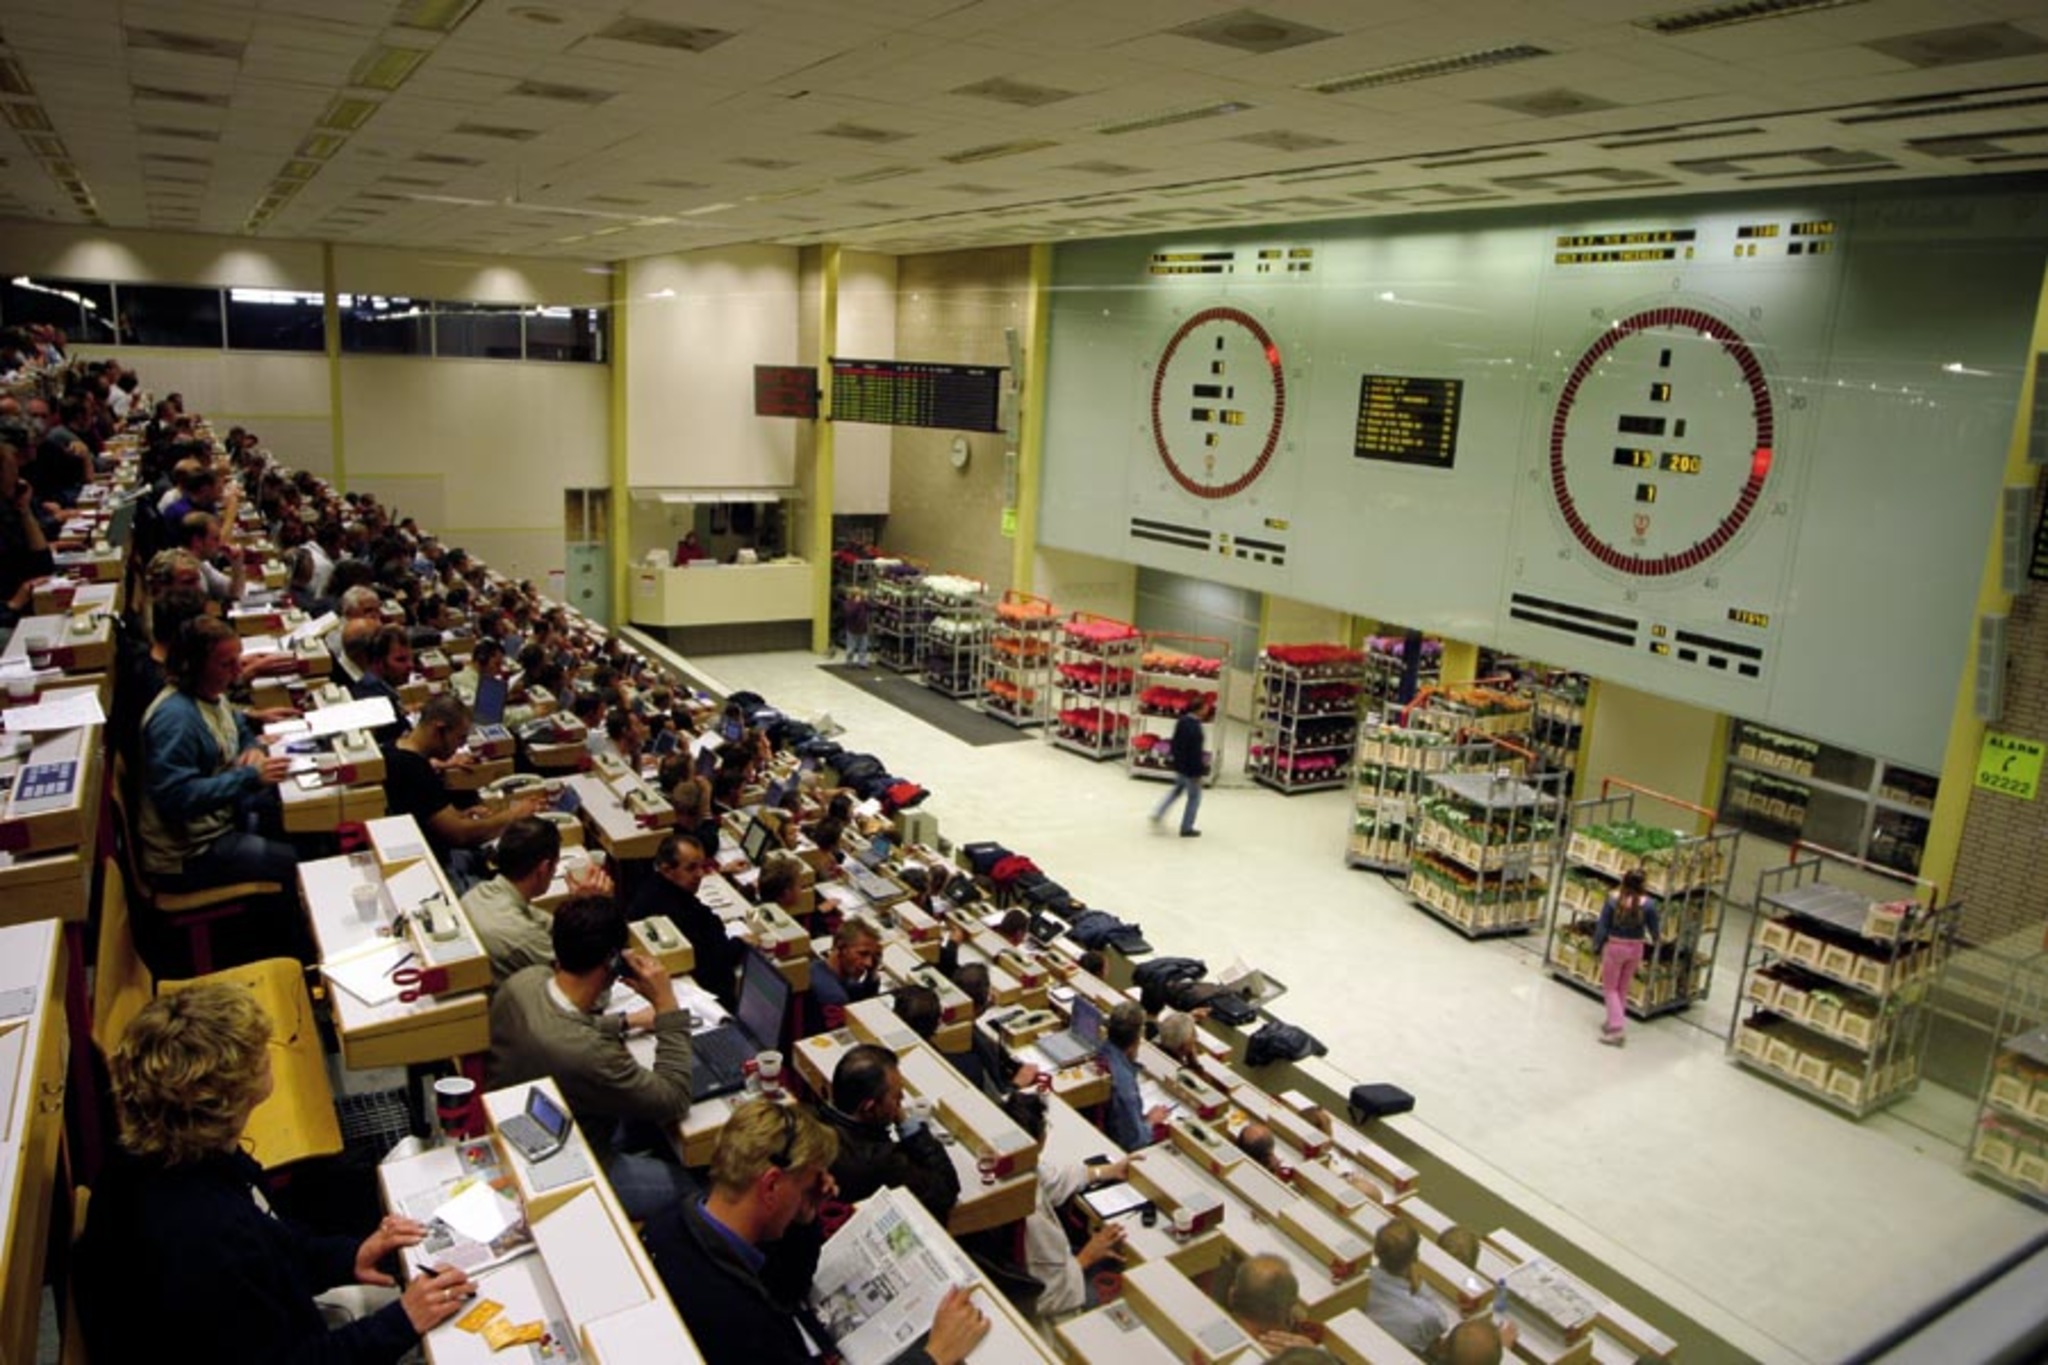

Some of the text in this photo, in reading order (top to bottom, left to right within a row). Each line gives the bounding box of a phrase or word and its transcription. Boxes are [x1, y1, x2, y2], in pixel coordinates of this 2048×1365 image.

[1669, 453, 1702, 474] 200
[1990, 737, 2040, 755] ALARM
[1981, 771, 2031, 794] 92222
